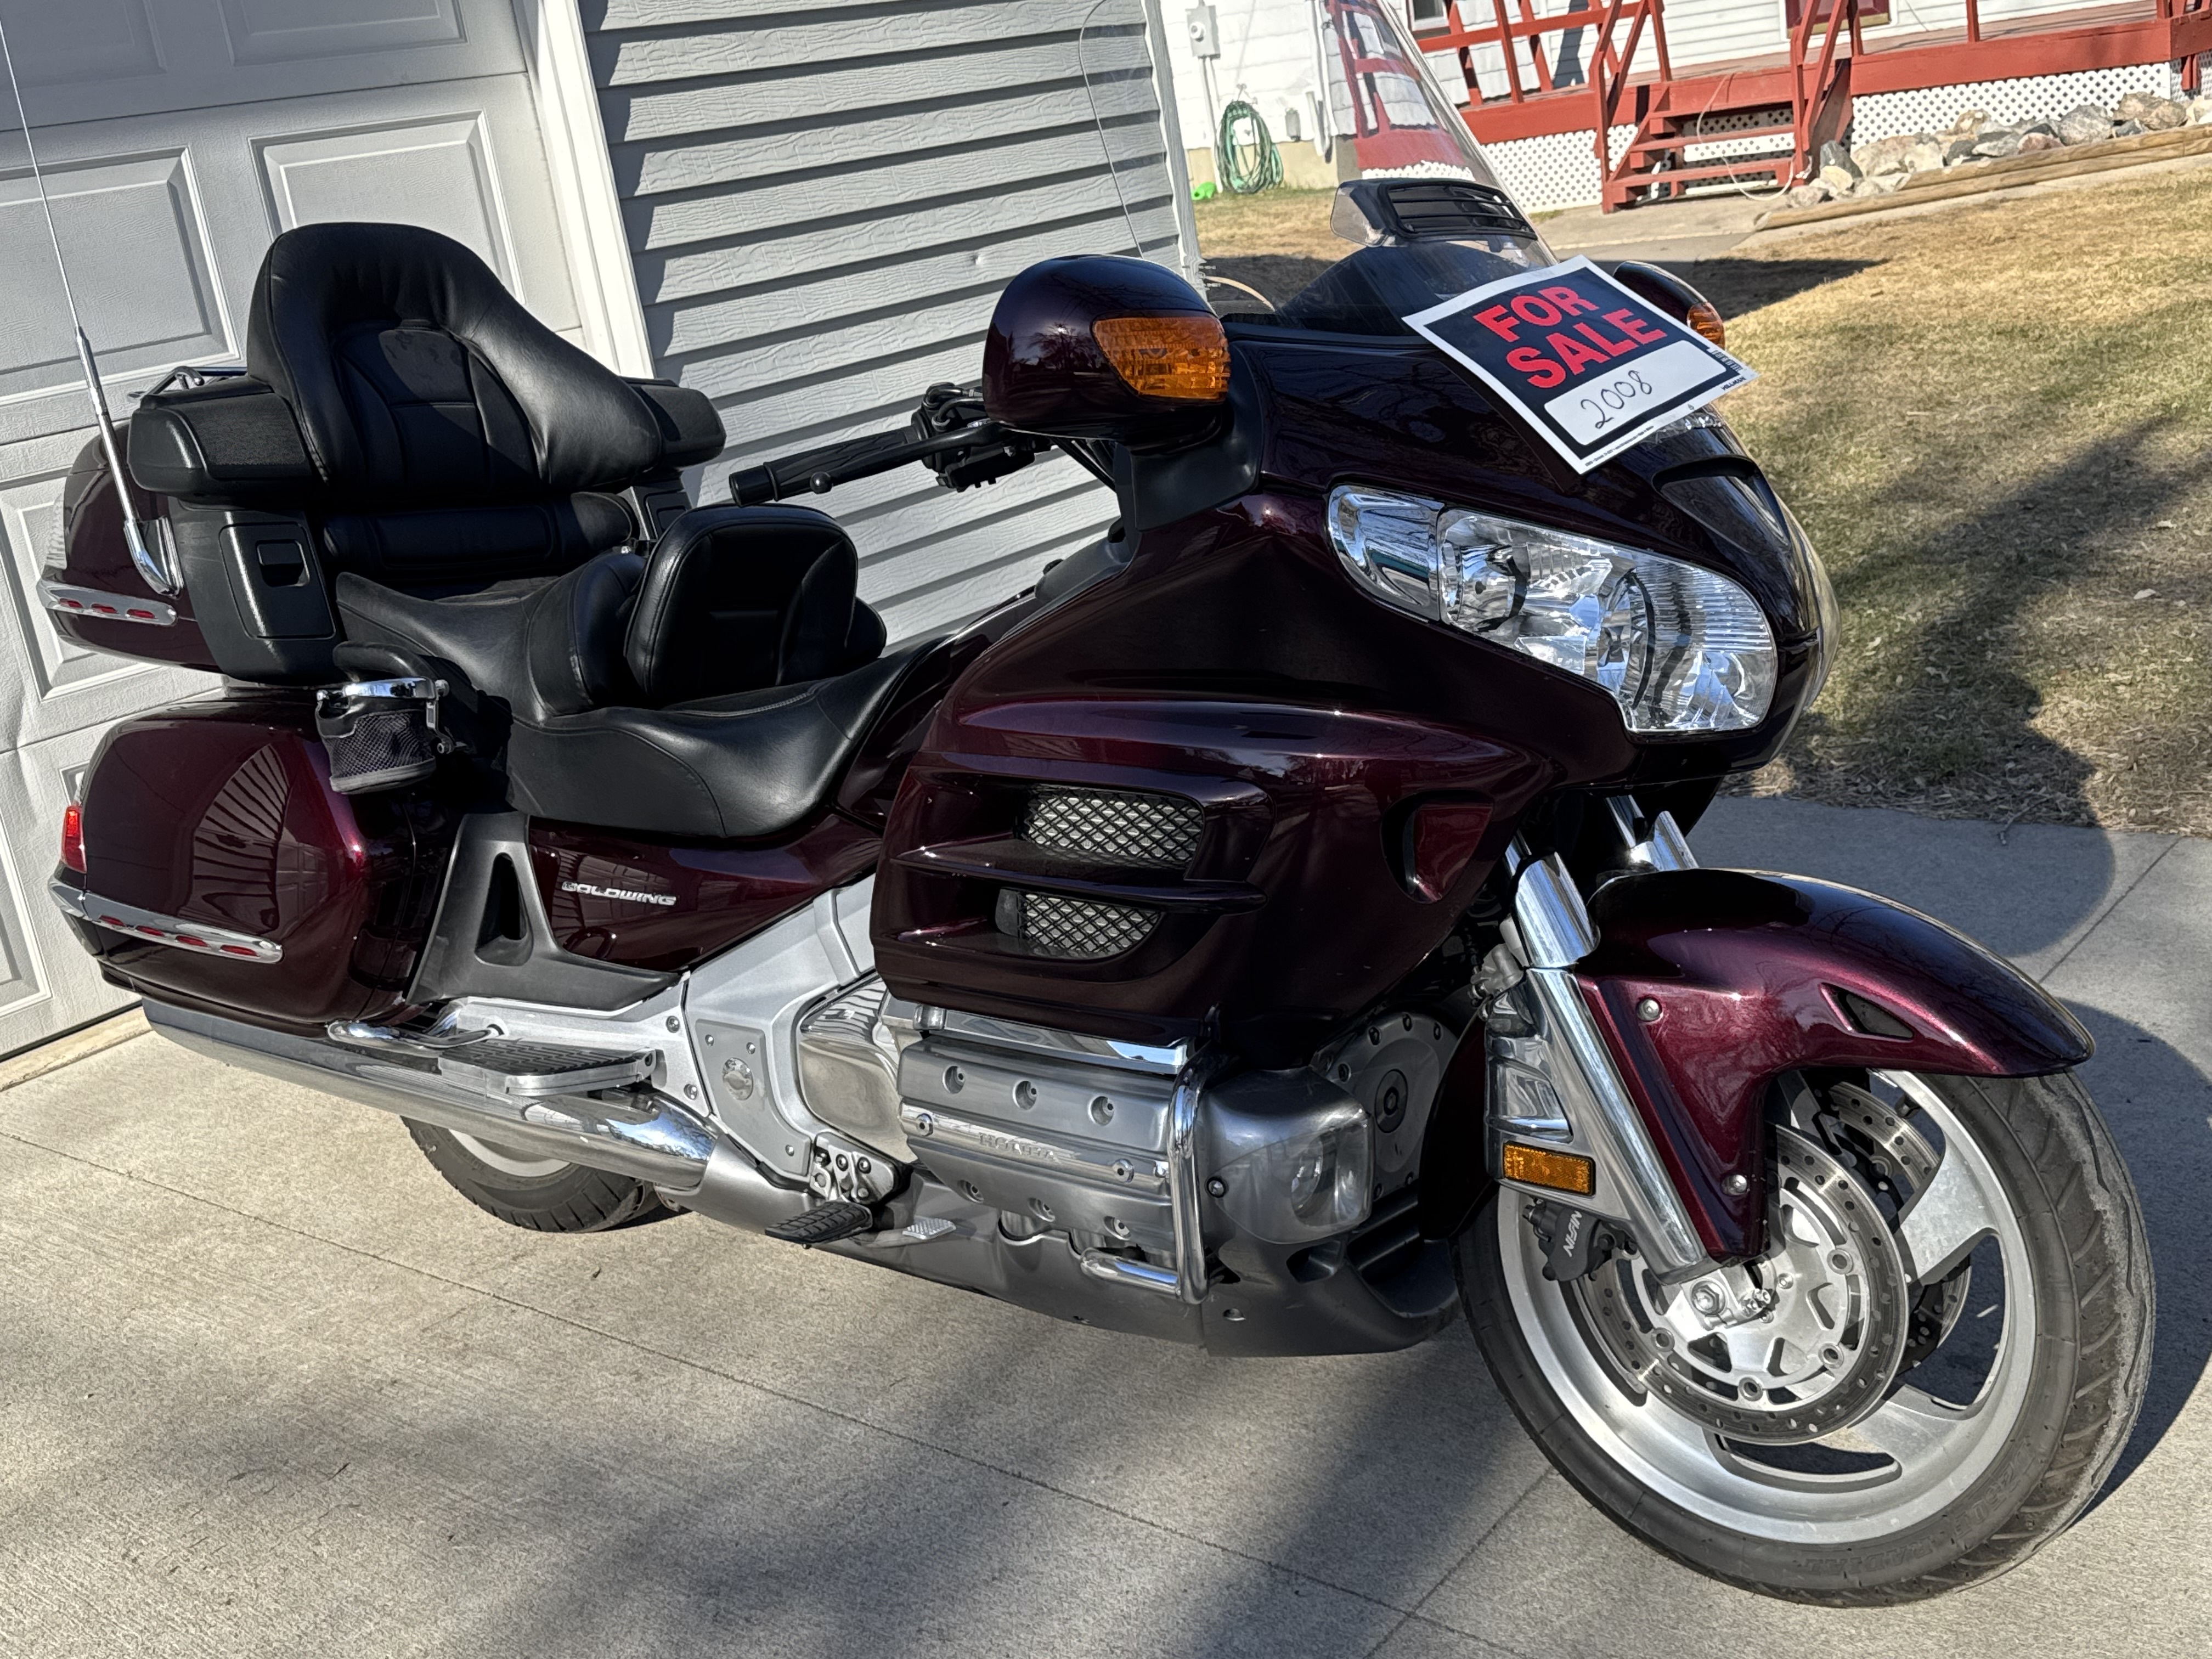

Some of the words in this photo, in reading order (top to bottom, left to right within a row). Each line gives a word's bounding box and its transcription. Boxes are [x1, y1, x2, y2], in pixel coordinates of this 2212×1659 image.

[1473, 286, 1600, 342] FOR
[1506, 309, 1667, 388] SALE
[1581, 370, 1652, 429] 2008
[562, 881, 676, 905] GOLDWING
